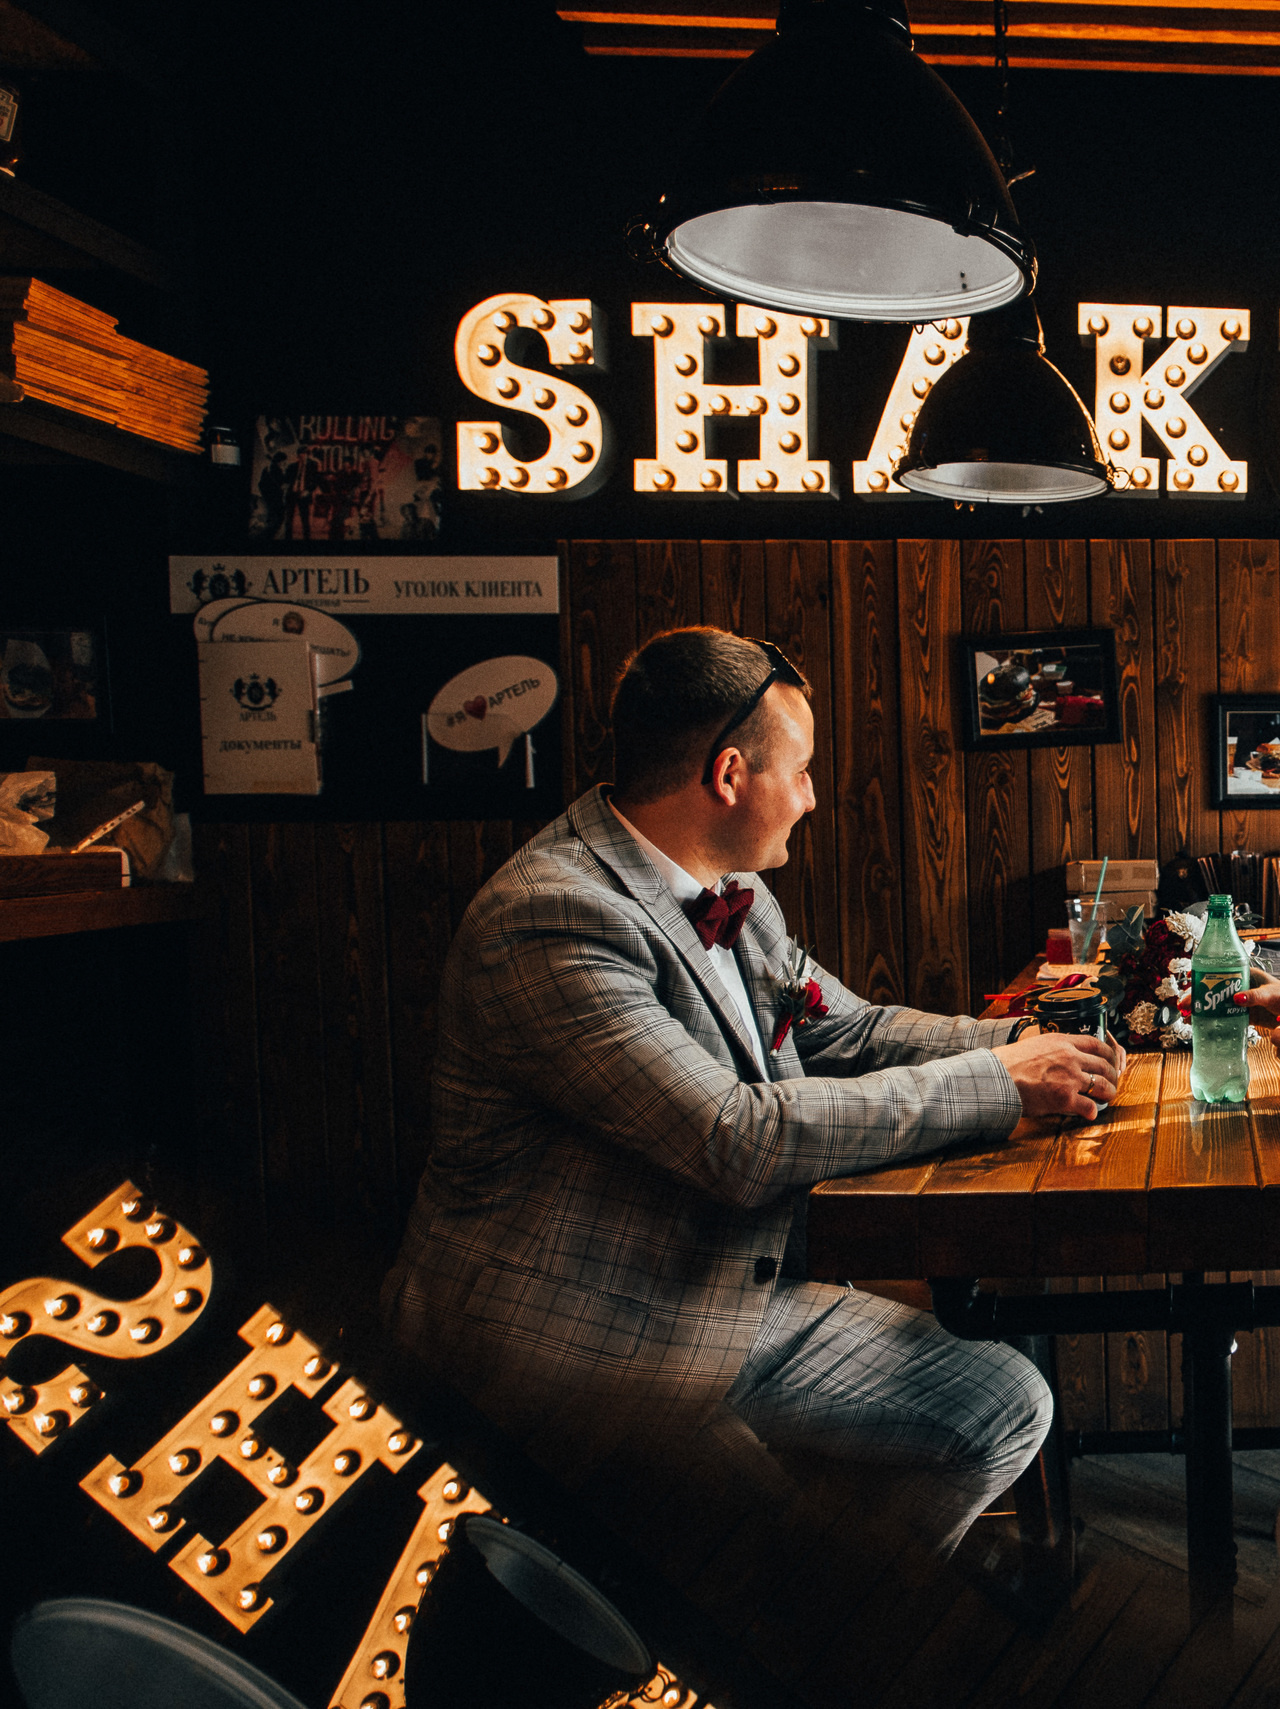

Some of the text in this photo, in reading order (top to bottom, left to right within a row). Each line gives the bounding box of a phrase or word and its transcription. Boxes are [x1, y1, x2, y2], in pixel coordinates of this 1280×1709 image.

[262, 568, 544, 599] АРТЕЛЬ УГОЛОК КЛИЕНТА
[488, 677, 542, 709] АРТЕЛЬ
[1203, 979, 1243, 1011] Sprite
